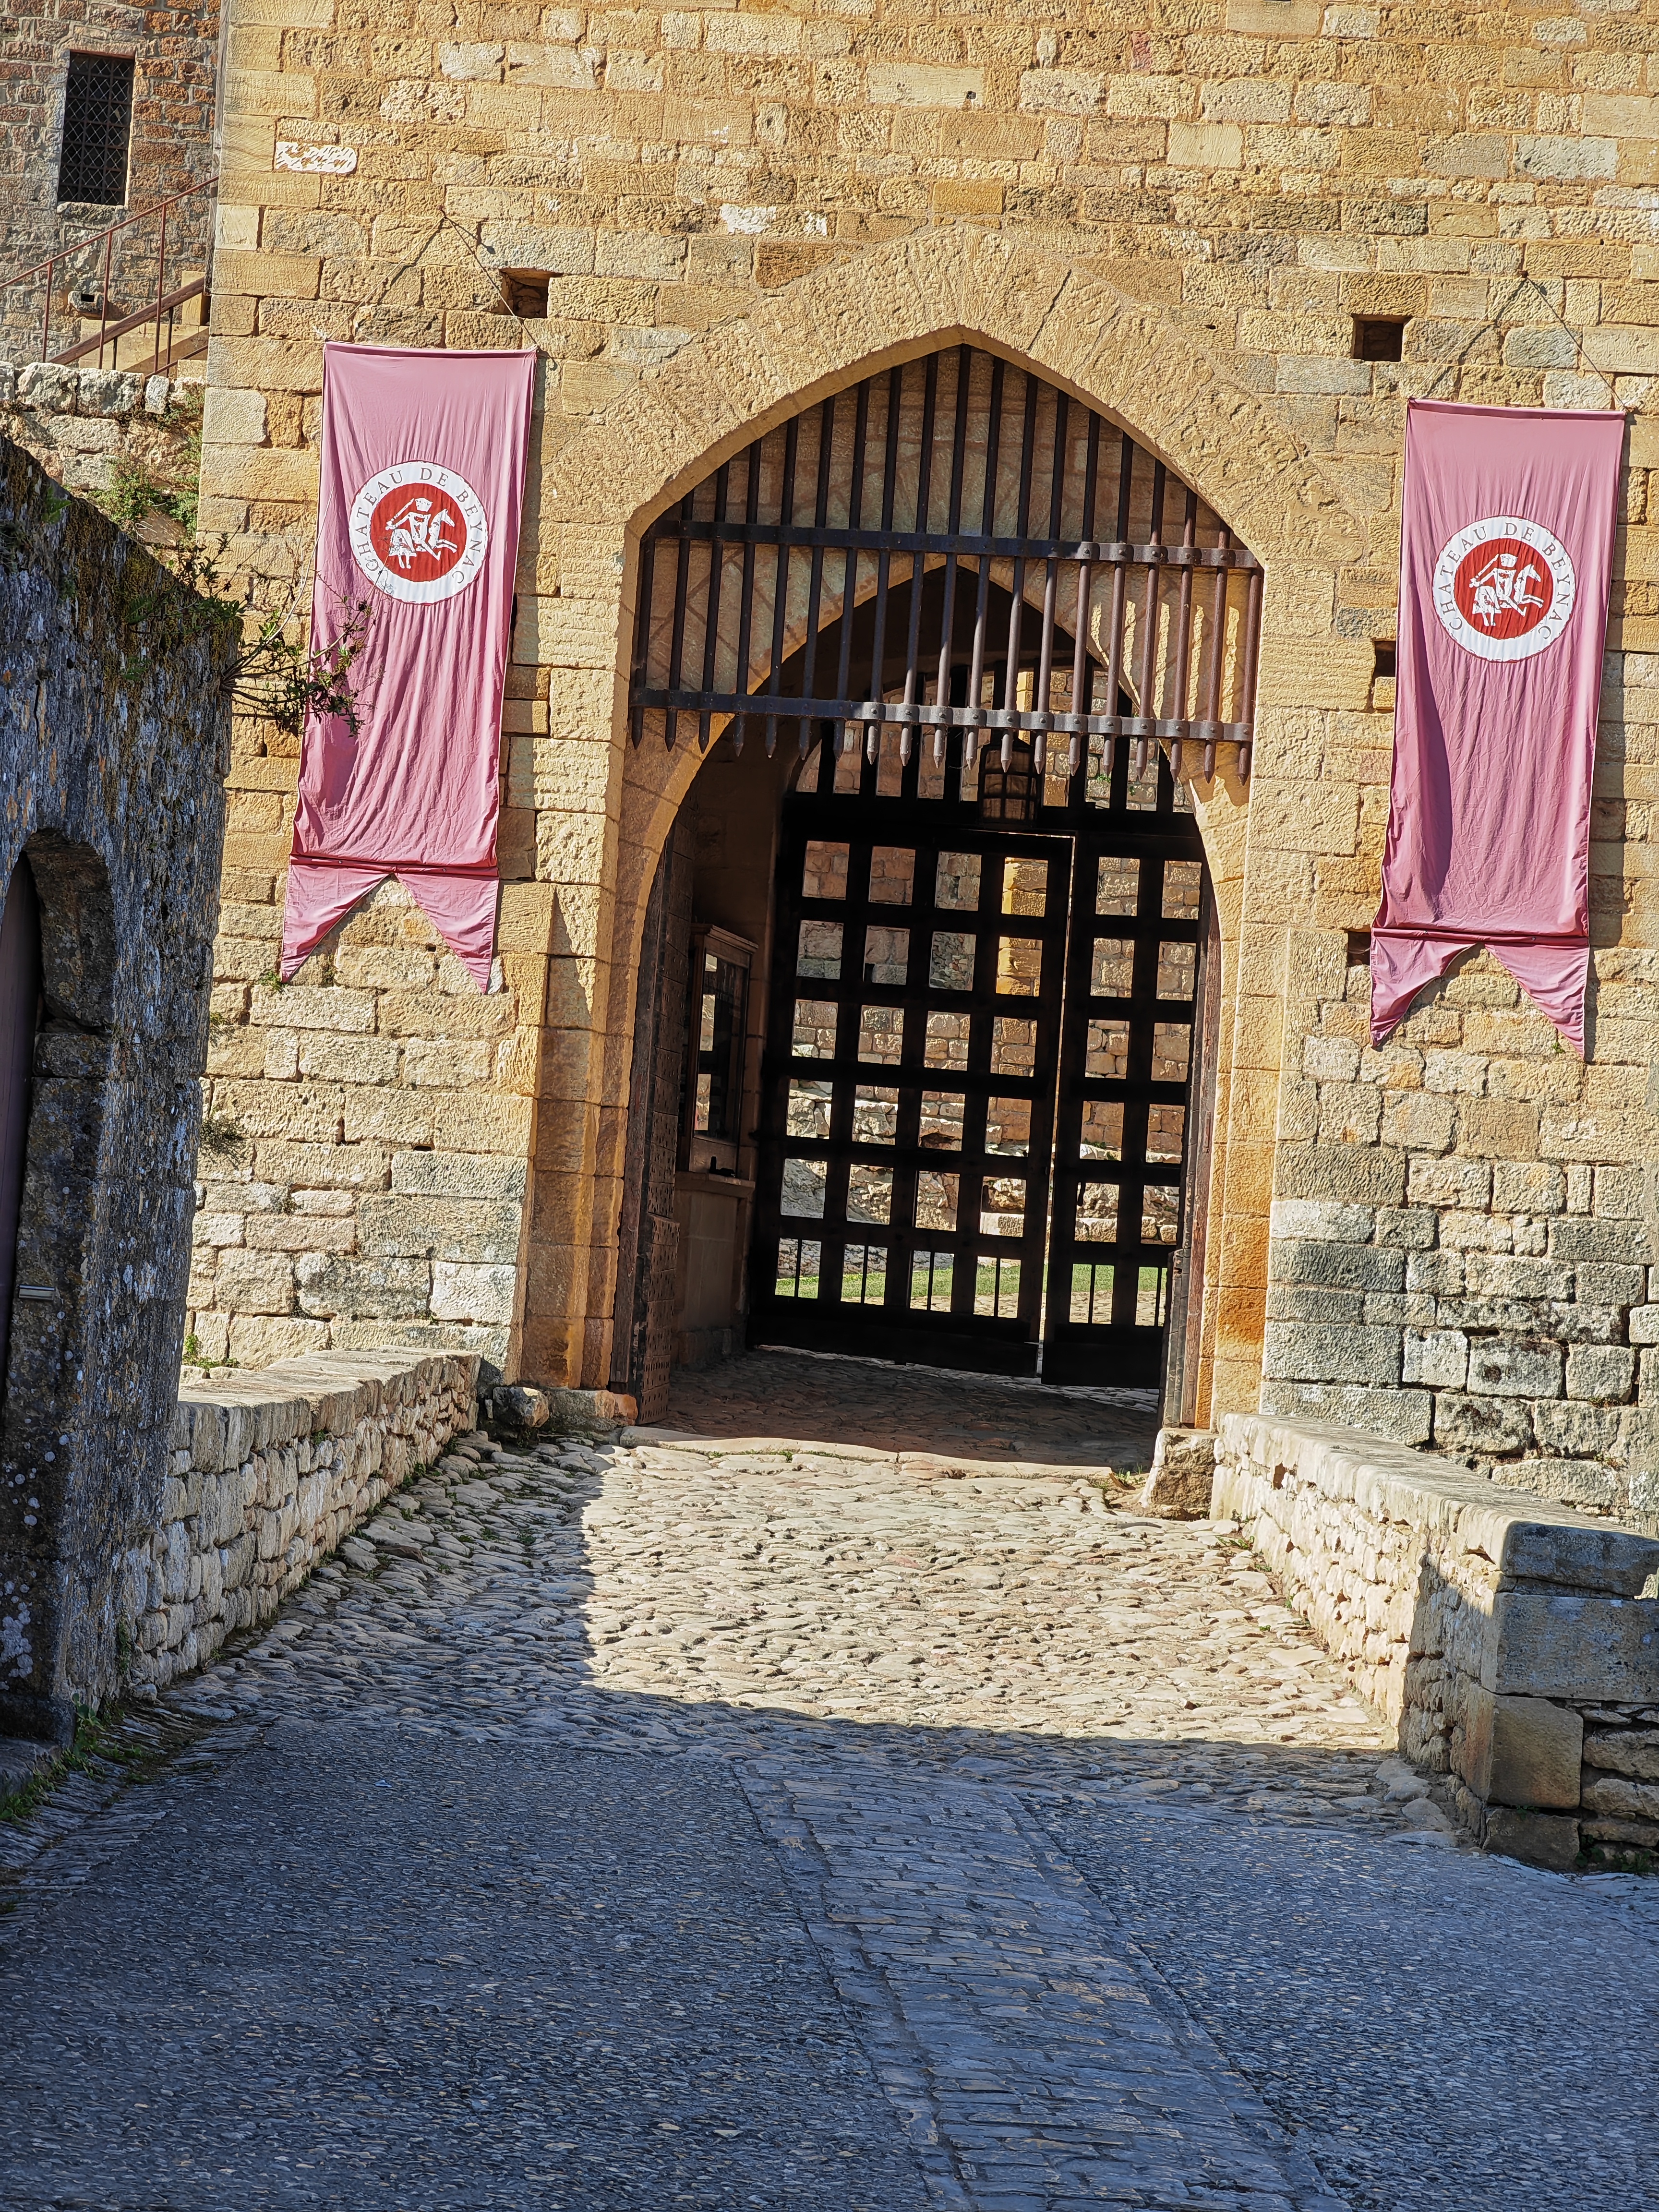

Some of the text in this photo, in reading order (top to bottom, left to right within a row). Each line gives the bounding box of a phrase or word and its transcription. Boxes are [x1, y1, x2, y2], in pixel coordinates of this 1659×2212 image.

[419, 468, 449, 487] DE
[452, 490, 483, 584] BEYNAC
[1438, 522, 1571, 640] CHATEAU DE BEYNAC
